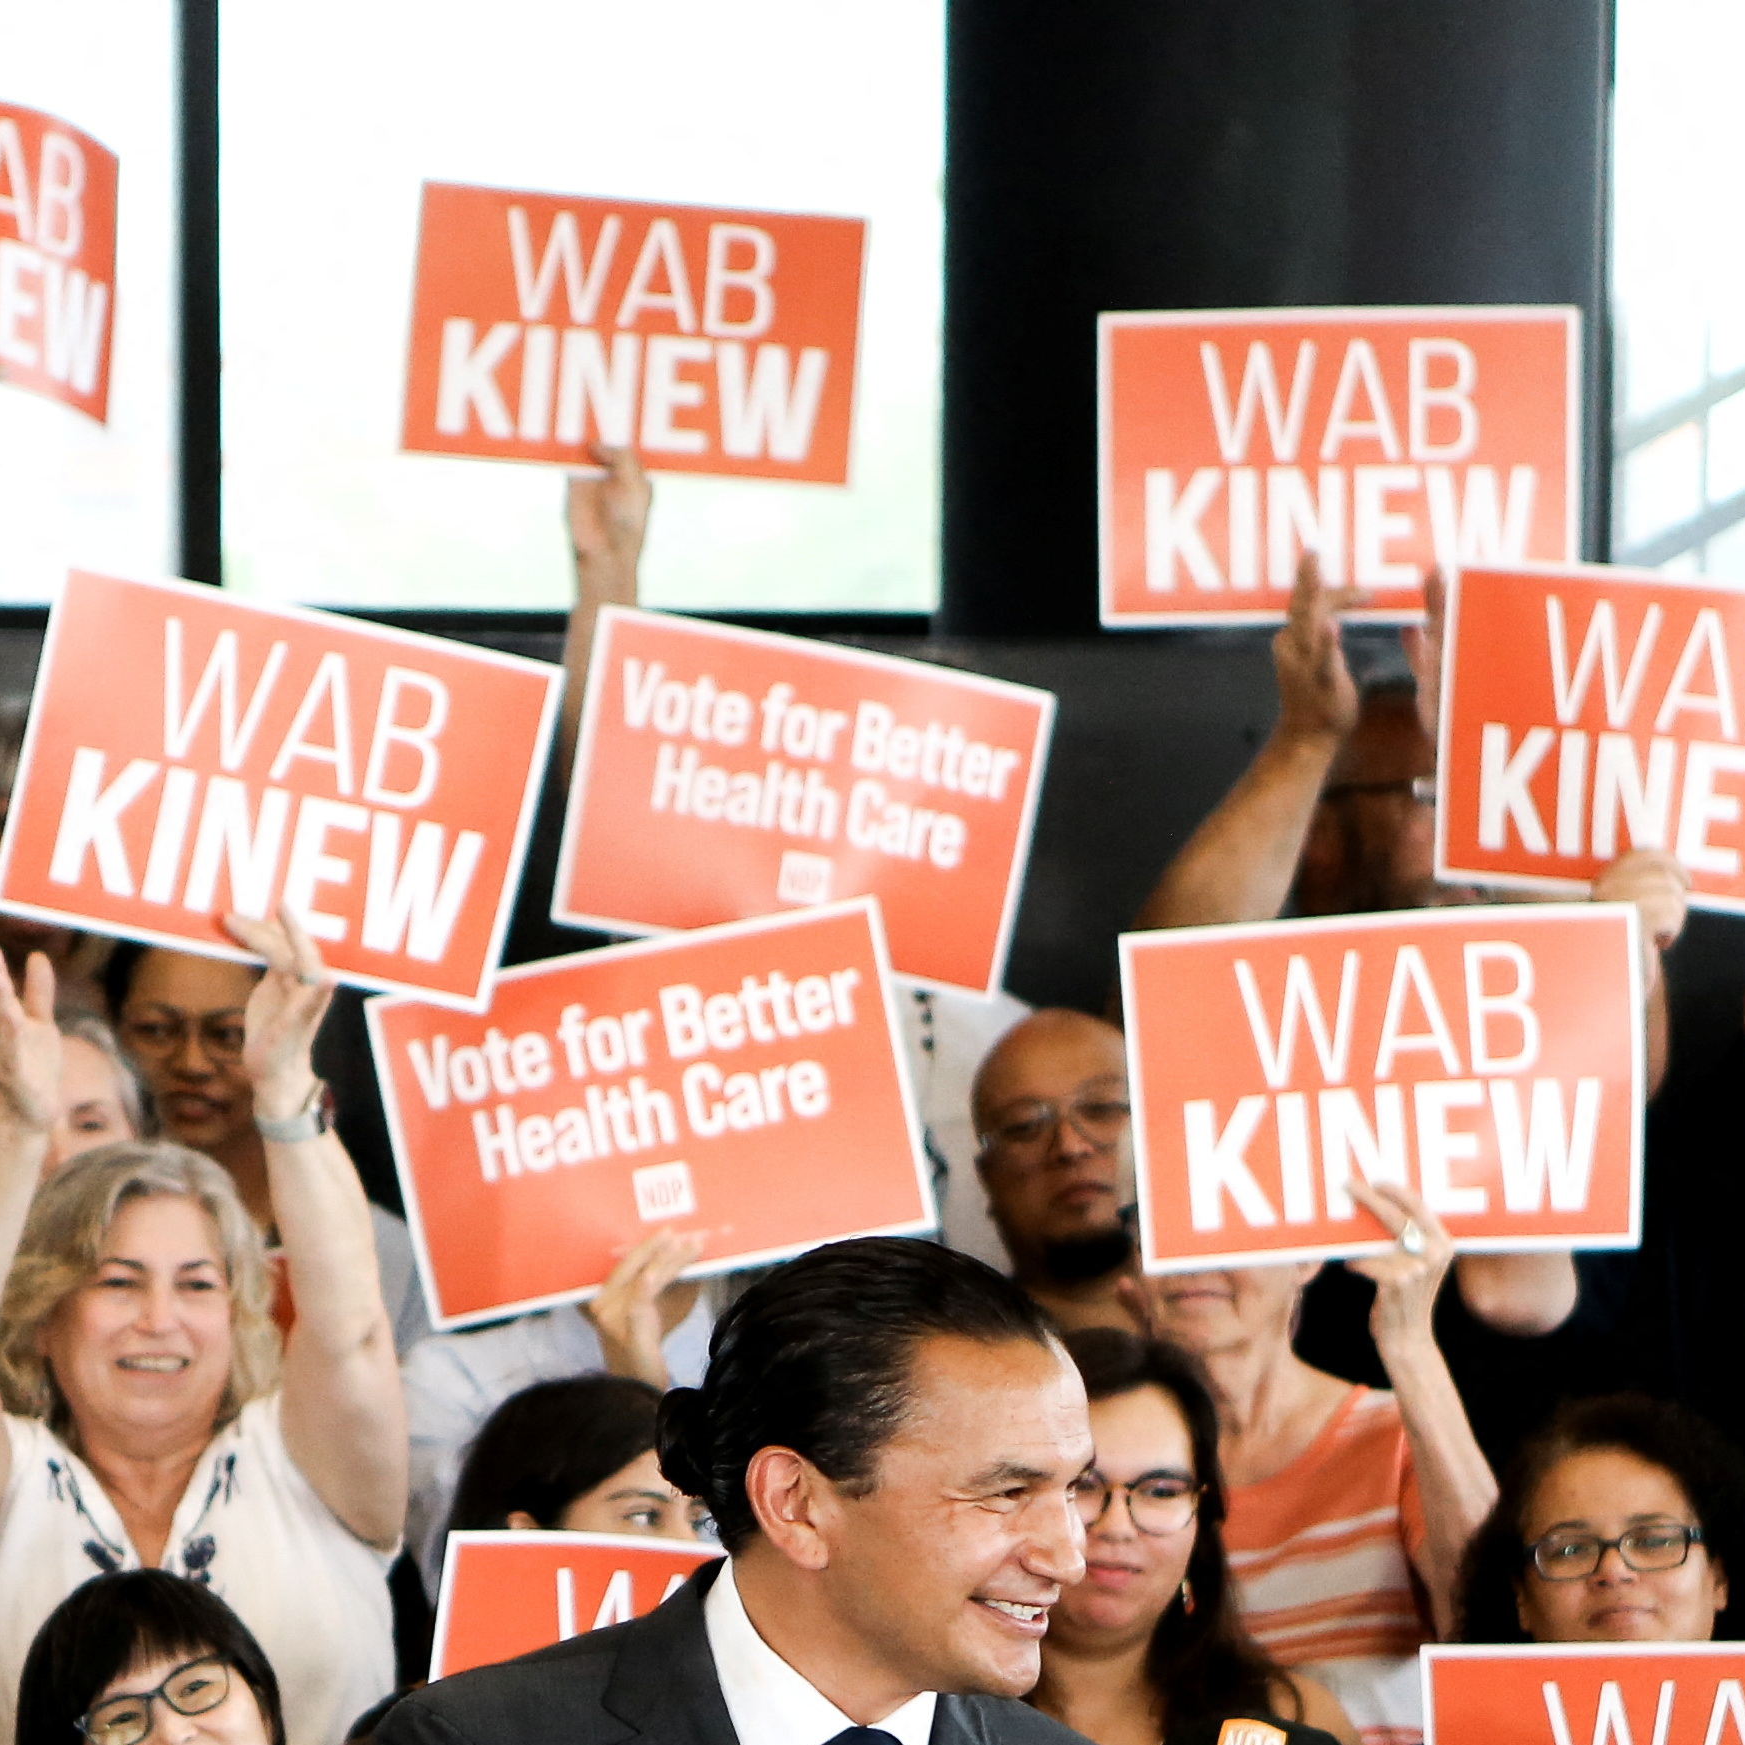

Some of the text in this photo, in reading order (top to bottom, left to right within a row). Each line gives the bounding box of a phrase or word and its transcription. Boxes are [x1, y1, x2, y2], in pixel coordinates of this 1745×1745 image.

[508, 208, 774, 339] WAB
[436, 319, 827, 462] KINEW
[1200, 336, 1478, 463] WAB
[1144, 465, 1536, 591] KINEW
[164, 617, 449, 809] WAB
[623, 658, 1018, 800] Vote for Better
[48, 746, 483, 964] KINEW
[651, 744, 966, 868] Health Care
[406, 969, 860, 1110] Vote for Better
[1234, 940, 1541, 1089] WAB
[473, 1061, 830, 1182] Health Care
[1183, 1079, 1601, 1233] KINEW
